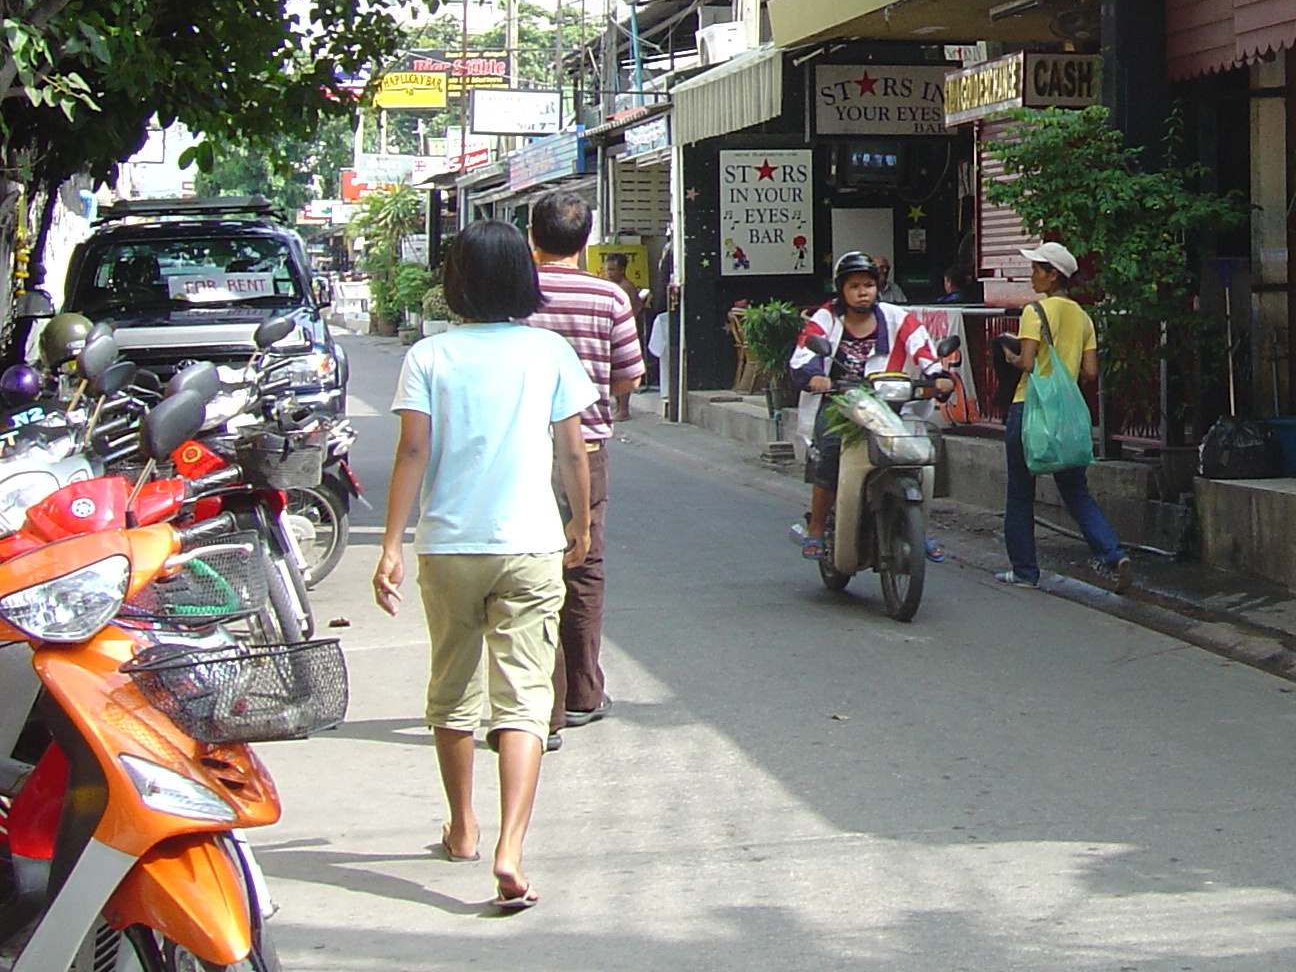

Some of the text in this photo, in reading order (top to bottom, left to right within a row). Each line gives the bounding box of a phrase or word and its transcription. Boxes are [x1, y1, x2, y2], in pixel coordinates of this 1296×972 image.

[1034, 60, 1095, 98] CASH
[835, 105, 942, 123] YOUR EYES
[913, 122, 949, 134] BAR
[729, 187, 803, 203] IN YOUR
[744, 208, 790, 224] EYES
[749, 228, 786, 244] BAR
[185, 278, 267, 294] FOR RENT
